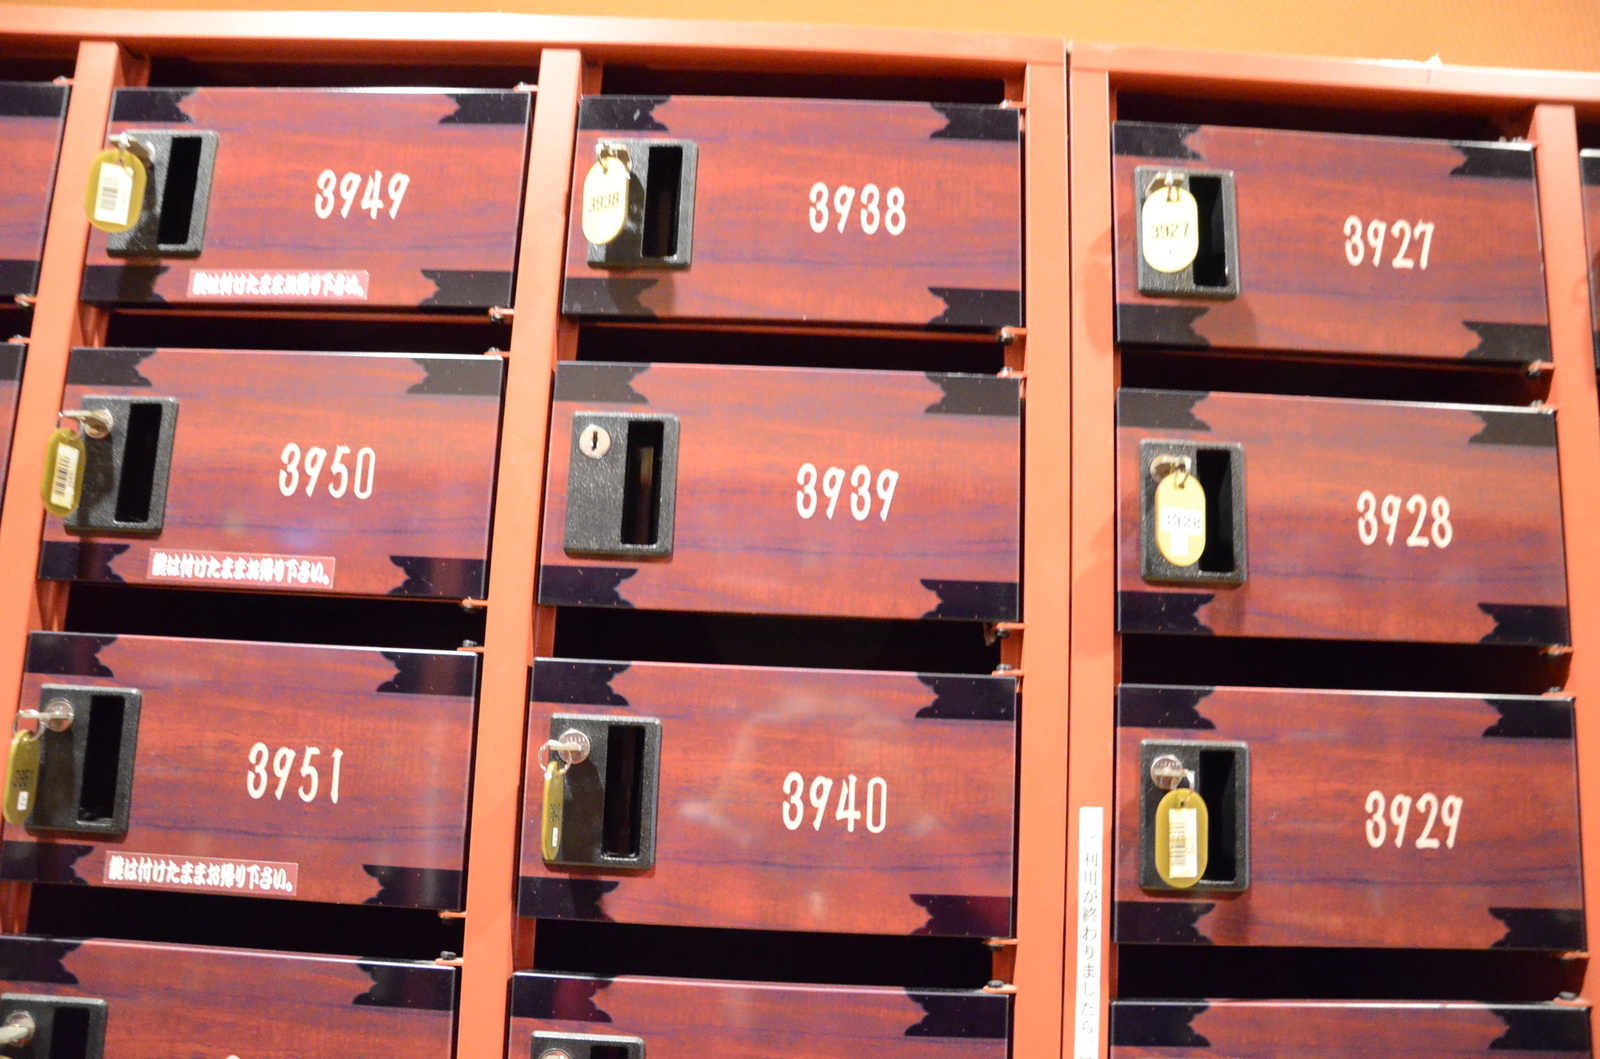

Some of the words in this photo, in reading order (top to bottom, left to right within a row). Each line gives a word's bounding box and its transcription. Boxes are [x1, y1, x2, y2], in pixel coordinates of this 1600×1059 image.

[314, 169, 410, 220] 3949
[589, 192, 619, 212] 3938
[809, 182, 906, 236] 3938
[1150, 222, 1189, 239] 3927
[1343, 216, 1434, 271] 3927
[278, 442, 376, 500] 3950
[796, 463, 899, 522] 3939
[1357, 491, 1453, 549] 3928
[247, 742, 344, 805] 3951
[782, 771, 887, 834] 3940
[1365, 791, 1463, 849] 3929
